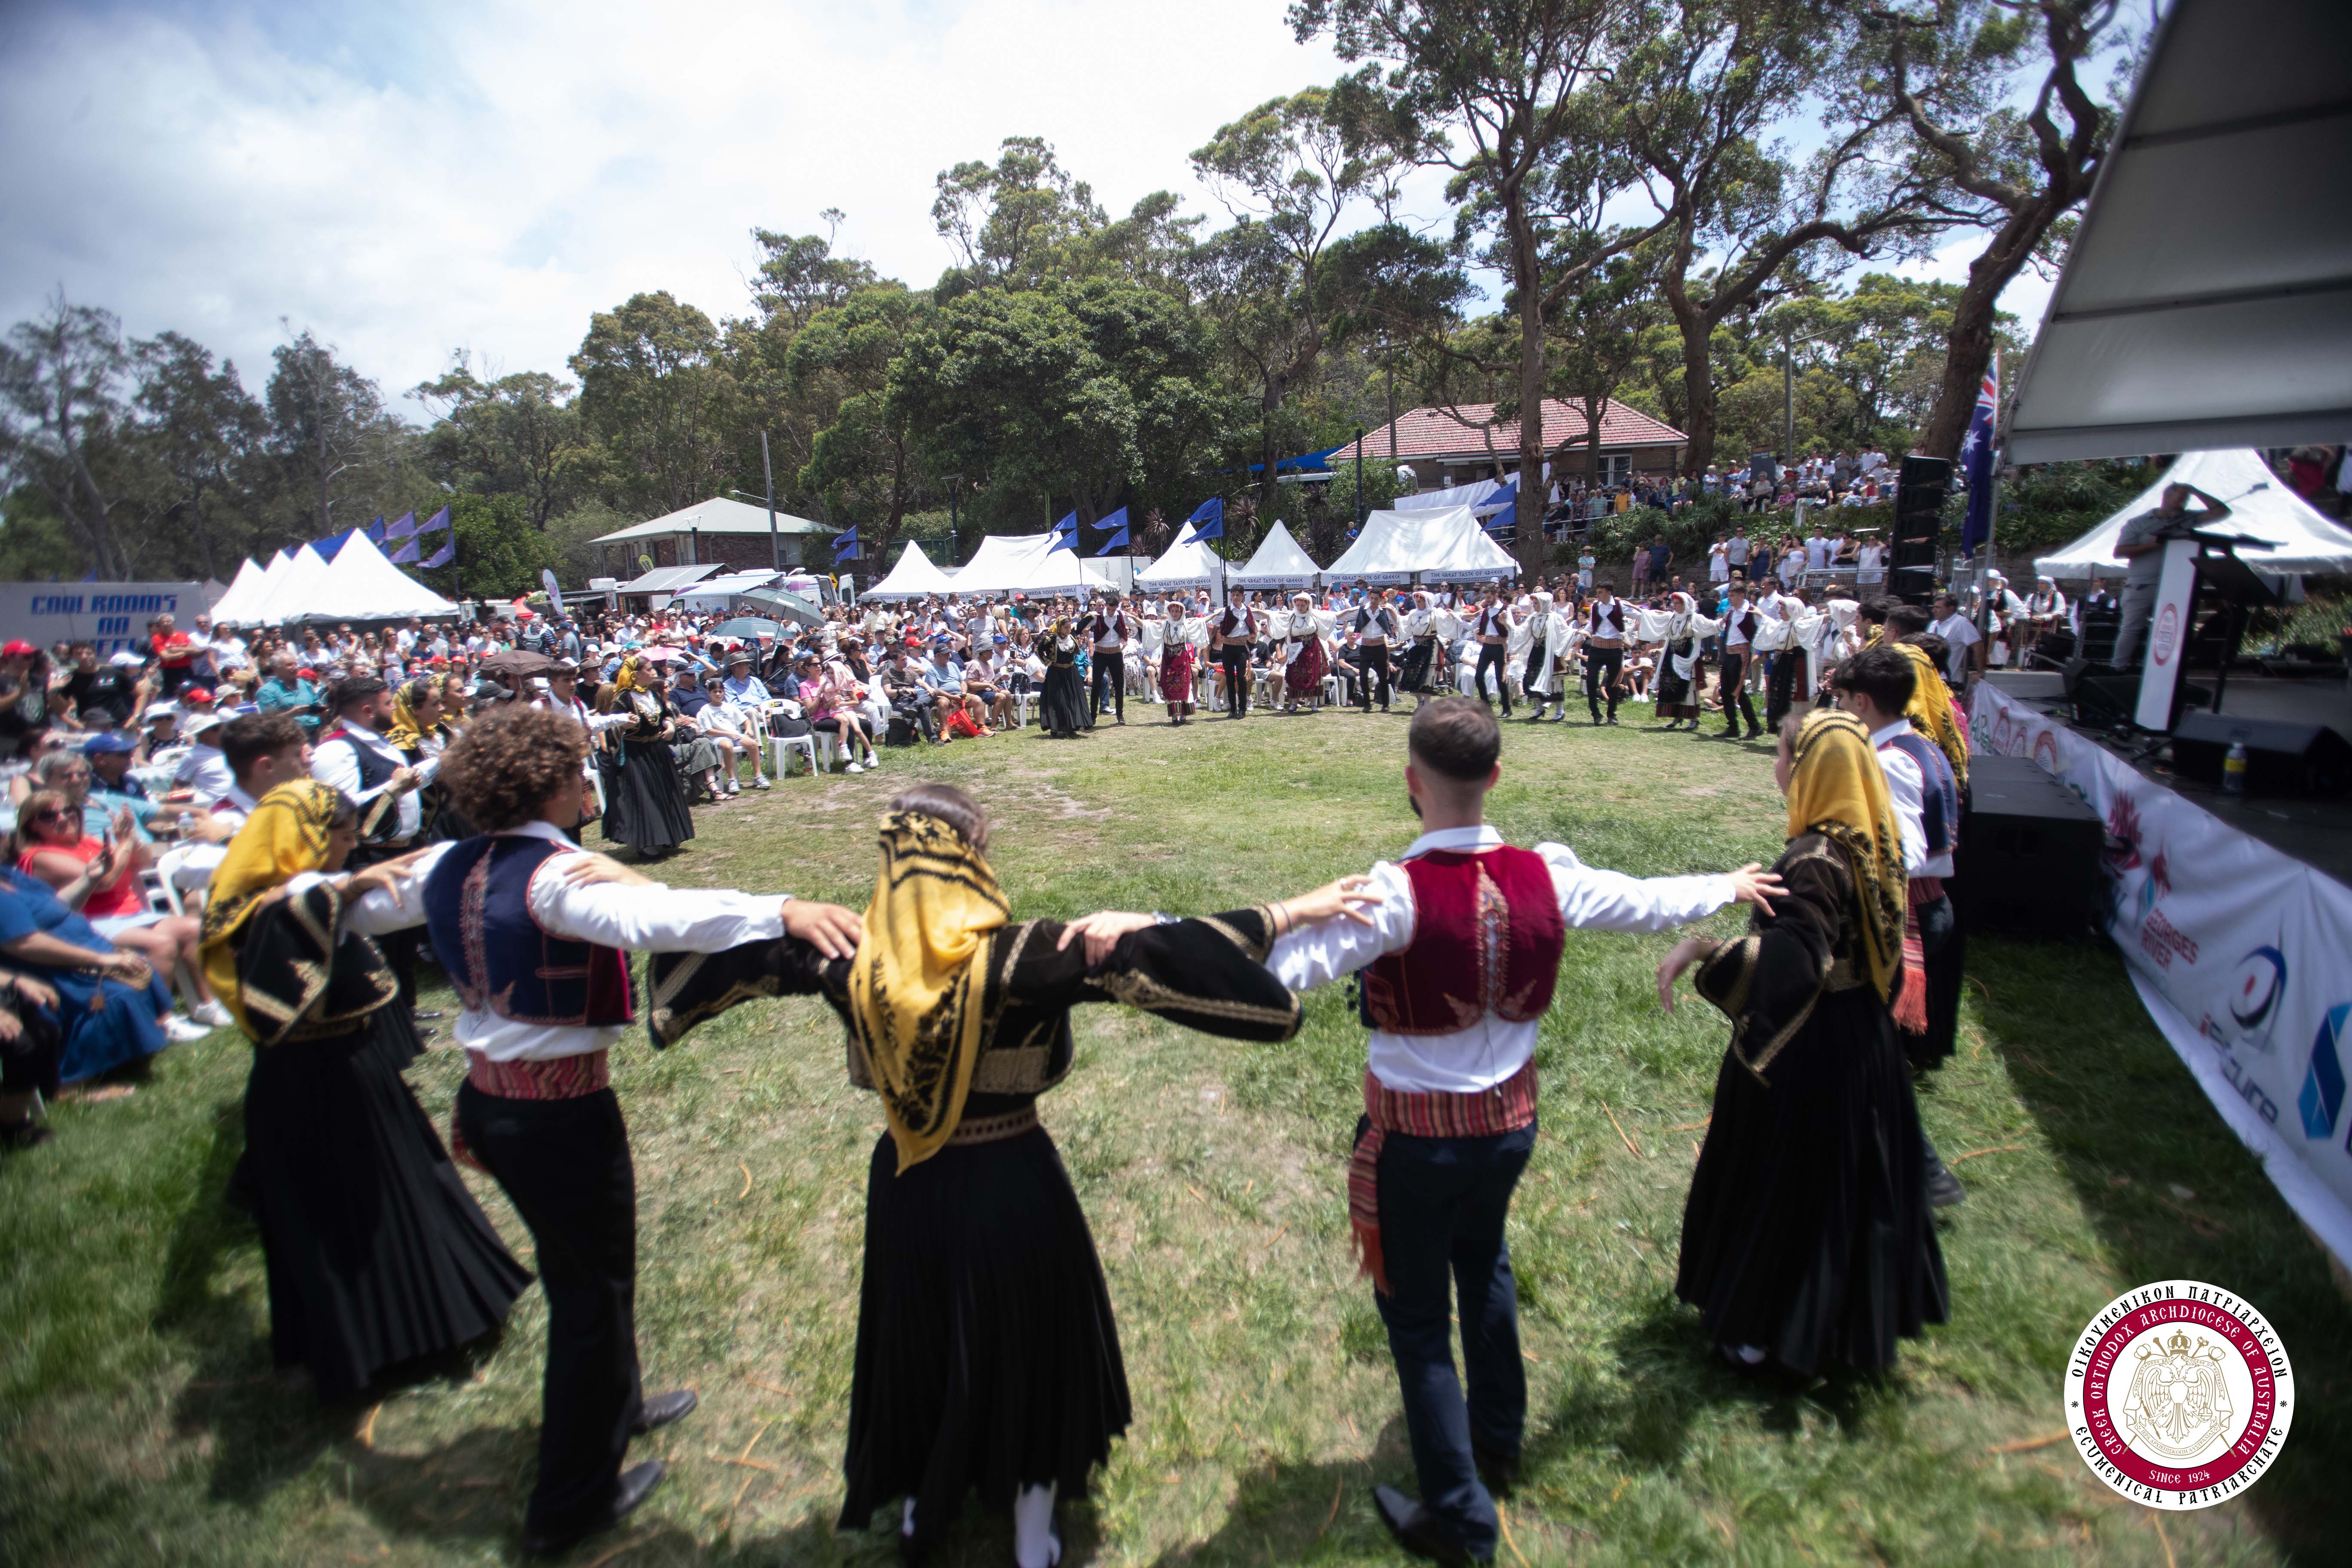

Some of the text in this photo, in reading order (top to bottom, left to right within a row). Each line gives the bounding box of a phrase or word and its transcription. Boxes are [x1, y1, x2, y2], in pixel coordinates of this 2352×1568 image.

[92, 594, 178, 613] ROOMS
[98, 617, 129, 635] ON
[2141, 927, 2172, 973] RIVER
[2146, 907, 2200, 965] GEORGES
